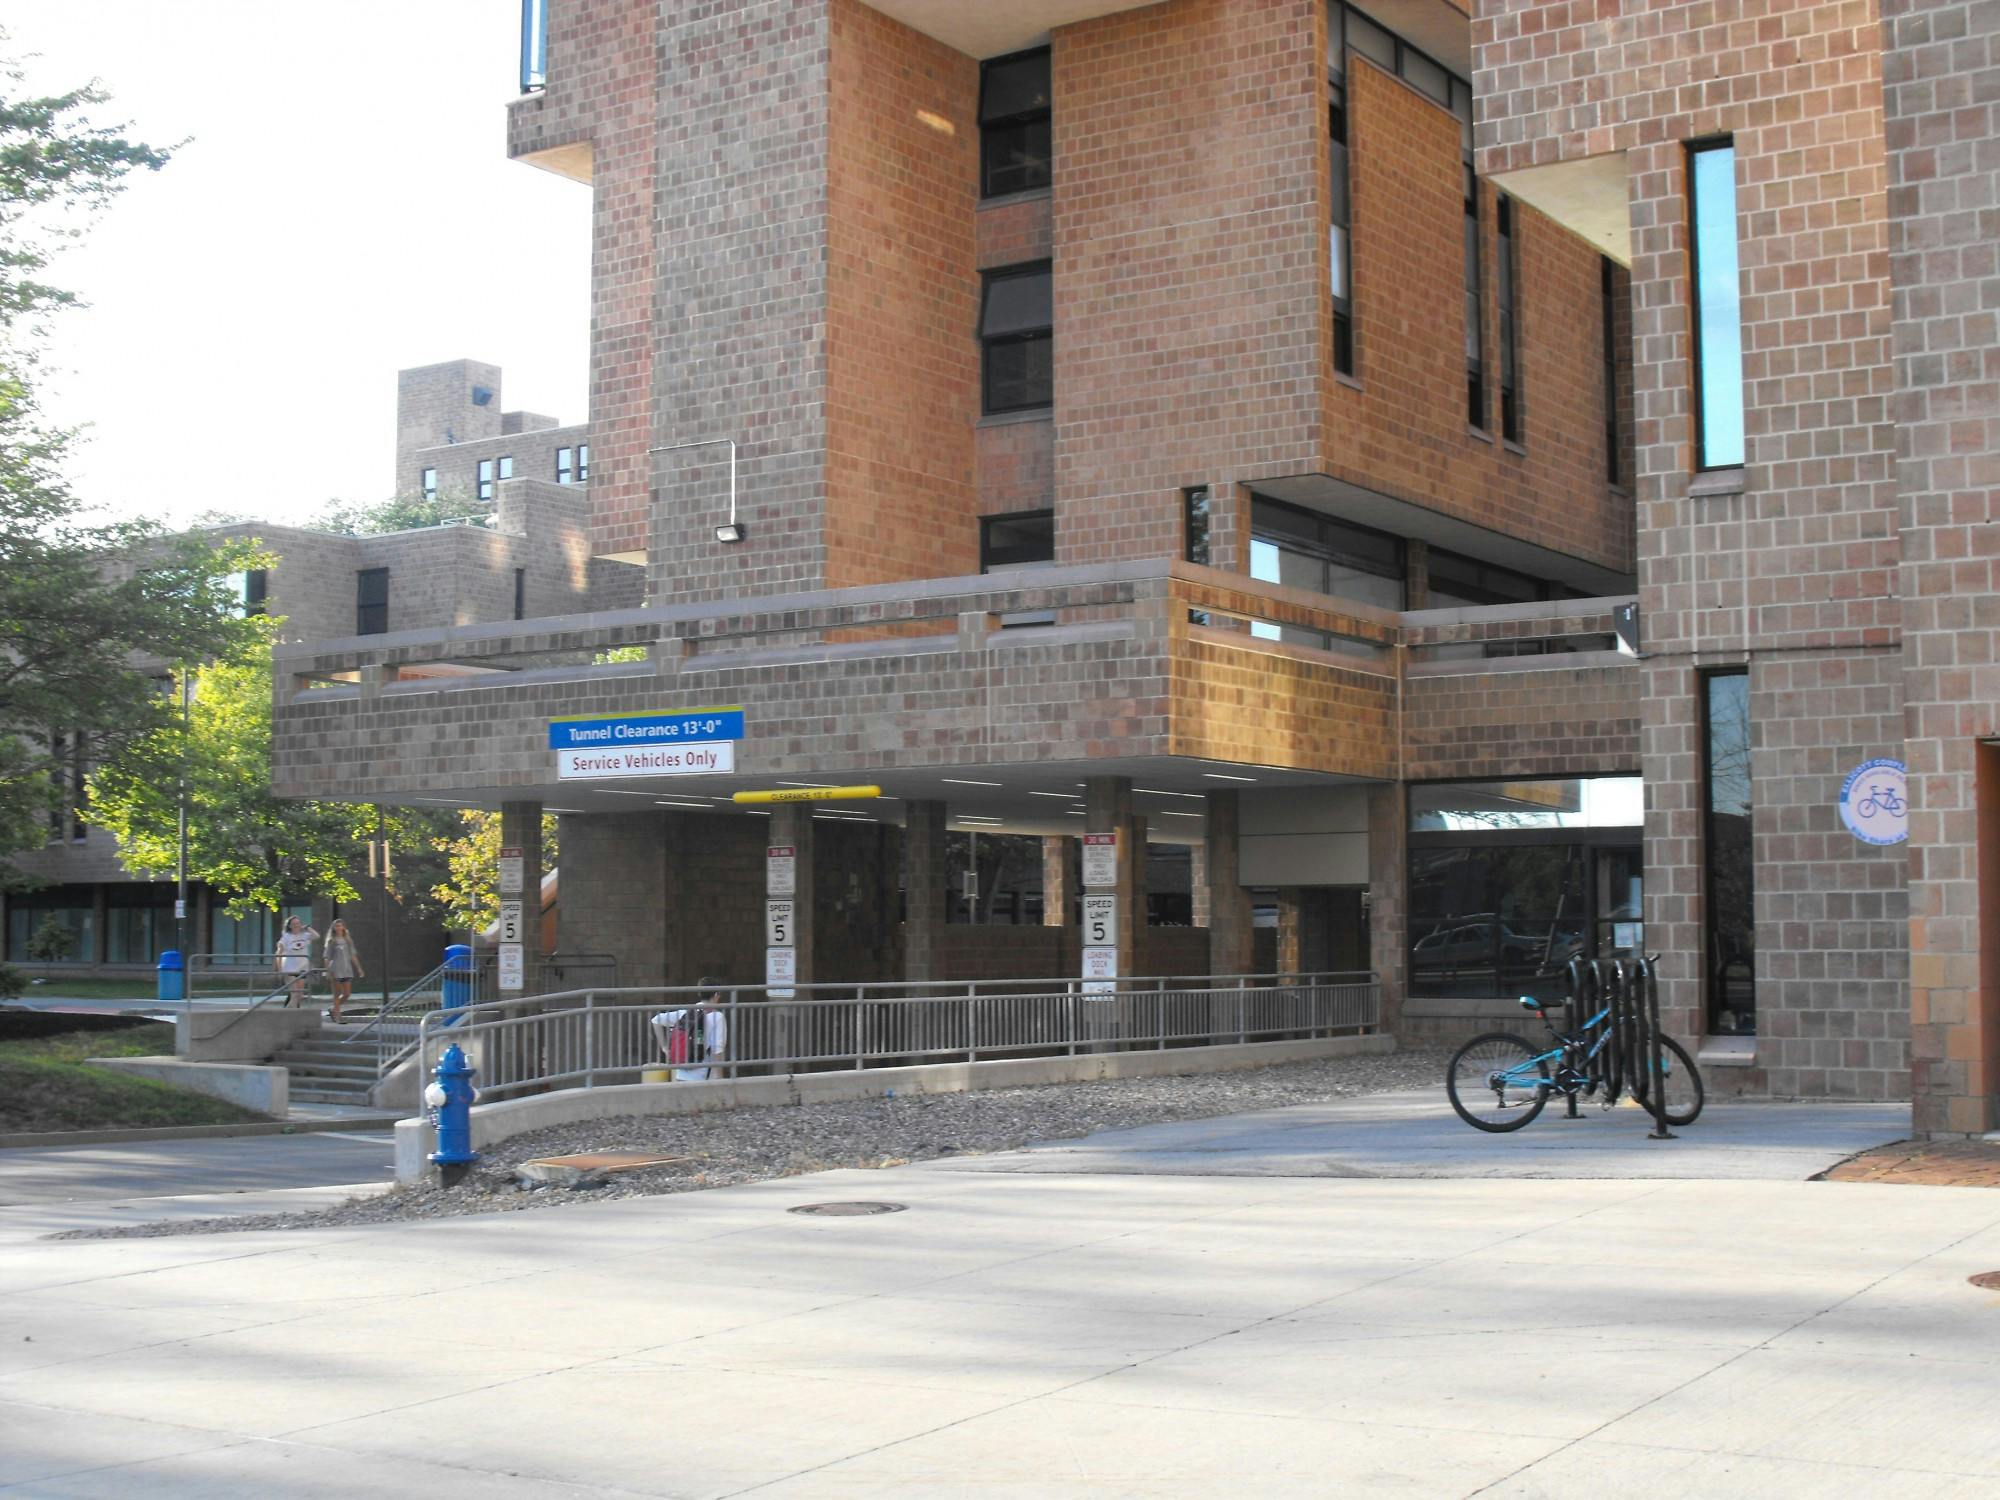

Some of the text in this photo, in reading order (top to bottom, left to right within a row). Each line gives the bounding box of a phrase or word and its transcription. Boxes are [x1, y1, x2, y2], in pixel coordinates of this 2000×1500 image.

[569, 719, 722, 741] Tunnel Clearance 13'-0"
[573, 750, 717, 771] Service Vehicles Only
[771, 792, 810, 801] CLEARANCE
[1087, 836, 1097, 844] 30
[769, 904, 792, 912] SPEED
[1087, 900, 1112, 908] SPEED
[771, 914, 789, 922] LIMIT
[1089, 911, 1109, 919] LIMIT
[506, 923, 516, 939] 5
[775, 924, 785, 942] 5
[1093, 922, 1105, 941] 5
[1087, 951, 1112, 959] LOADING
[1091, 960, 1108, 968] DOCK
